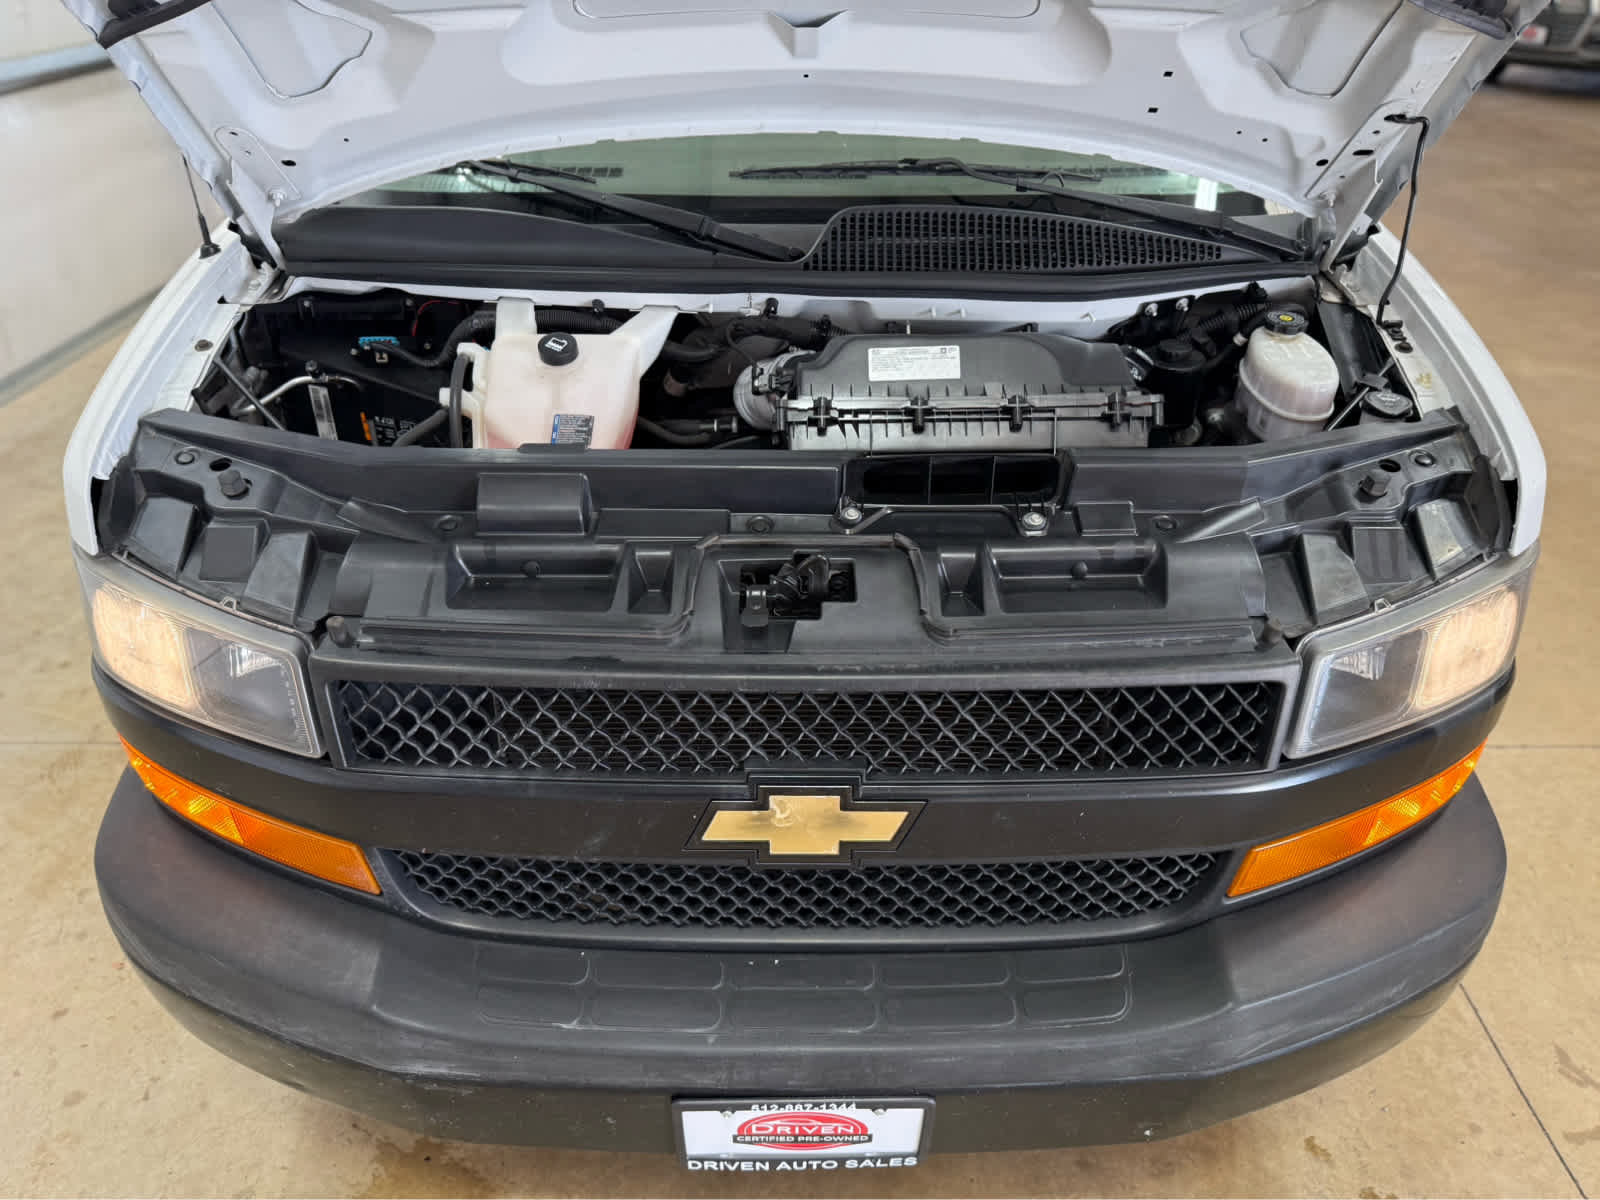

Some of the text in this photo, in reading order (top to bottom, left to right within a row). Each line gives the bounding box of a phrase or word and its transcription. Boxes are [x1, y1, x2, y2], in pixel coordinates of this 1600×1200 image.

[751, 1124, 854, 1134] DRIVEN
[687, 1157, 918, 1171] DRIVEN AUTO SALES
